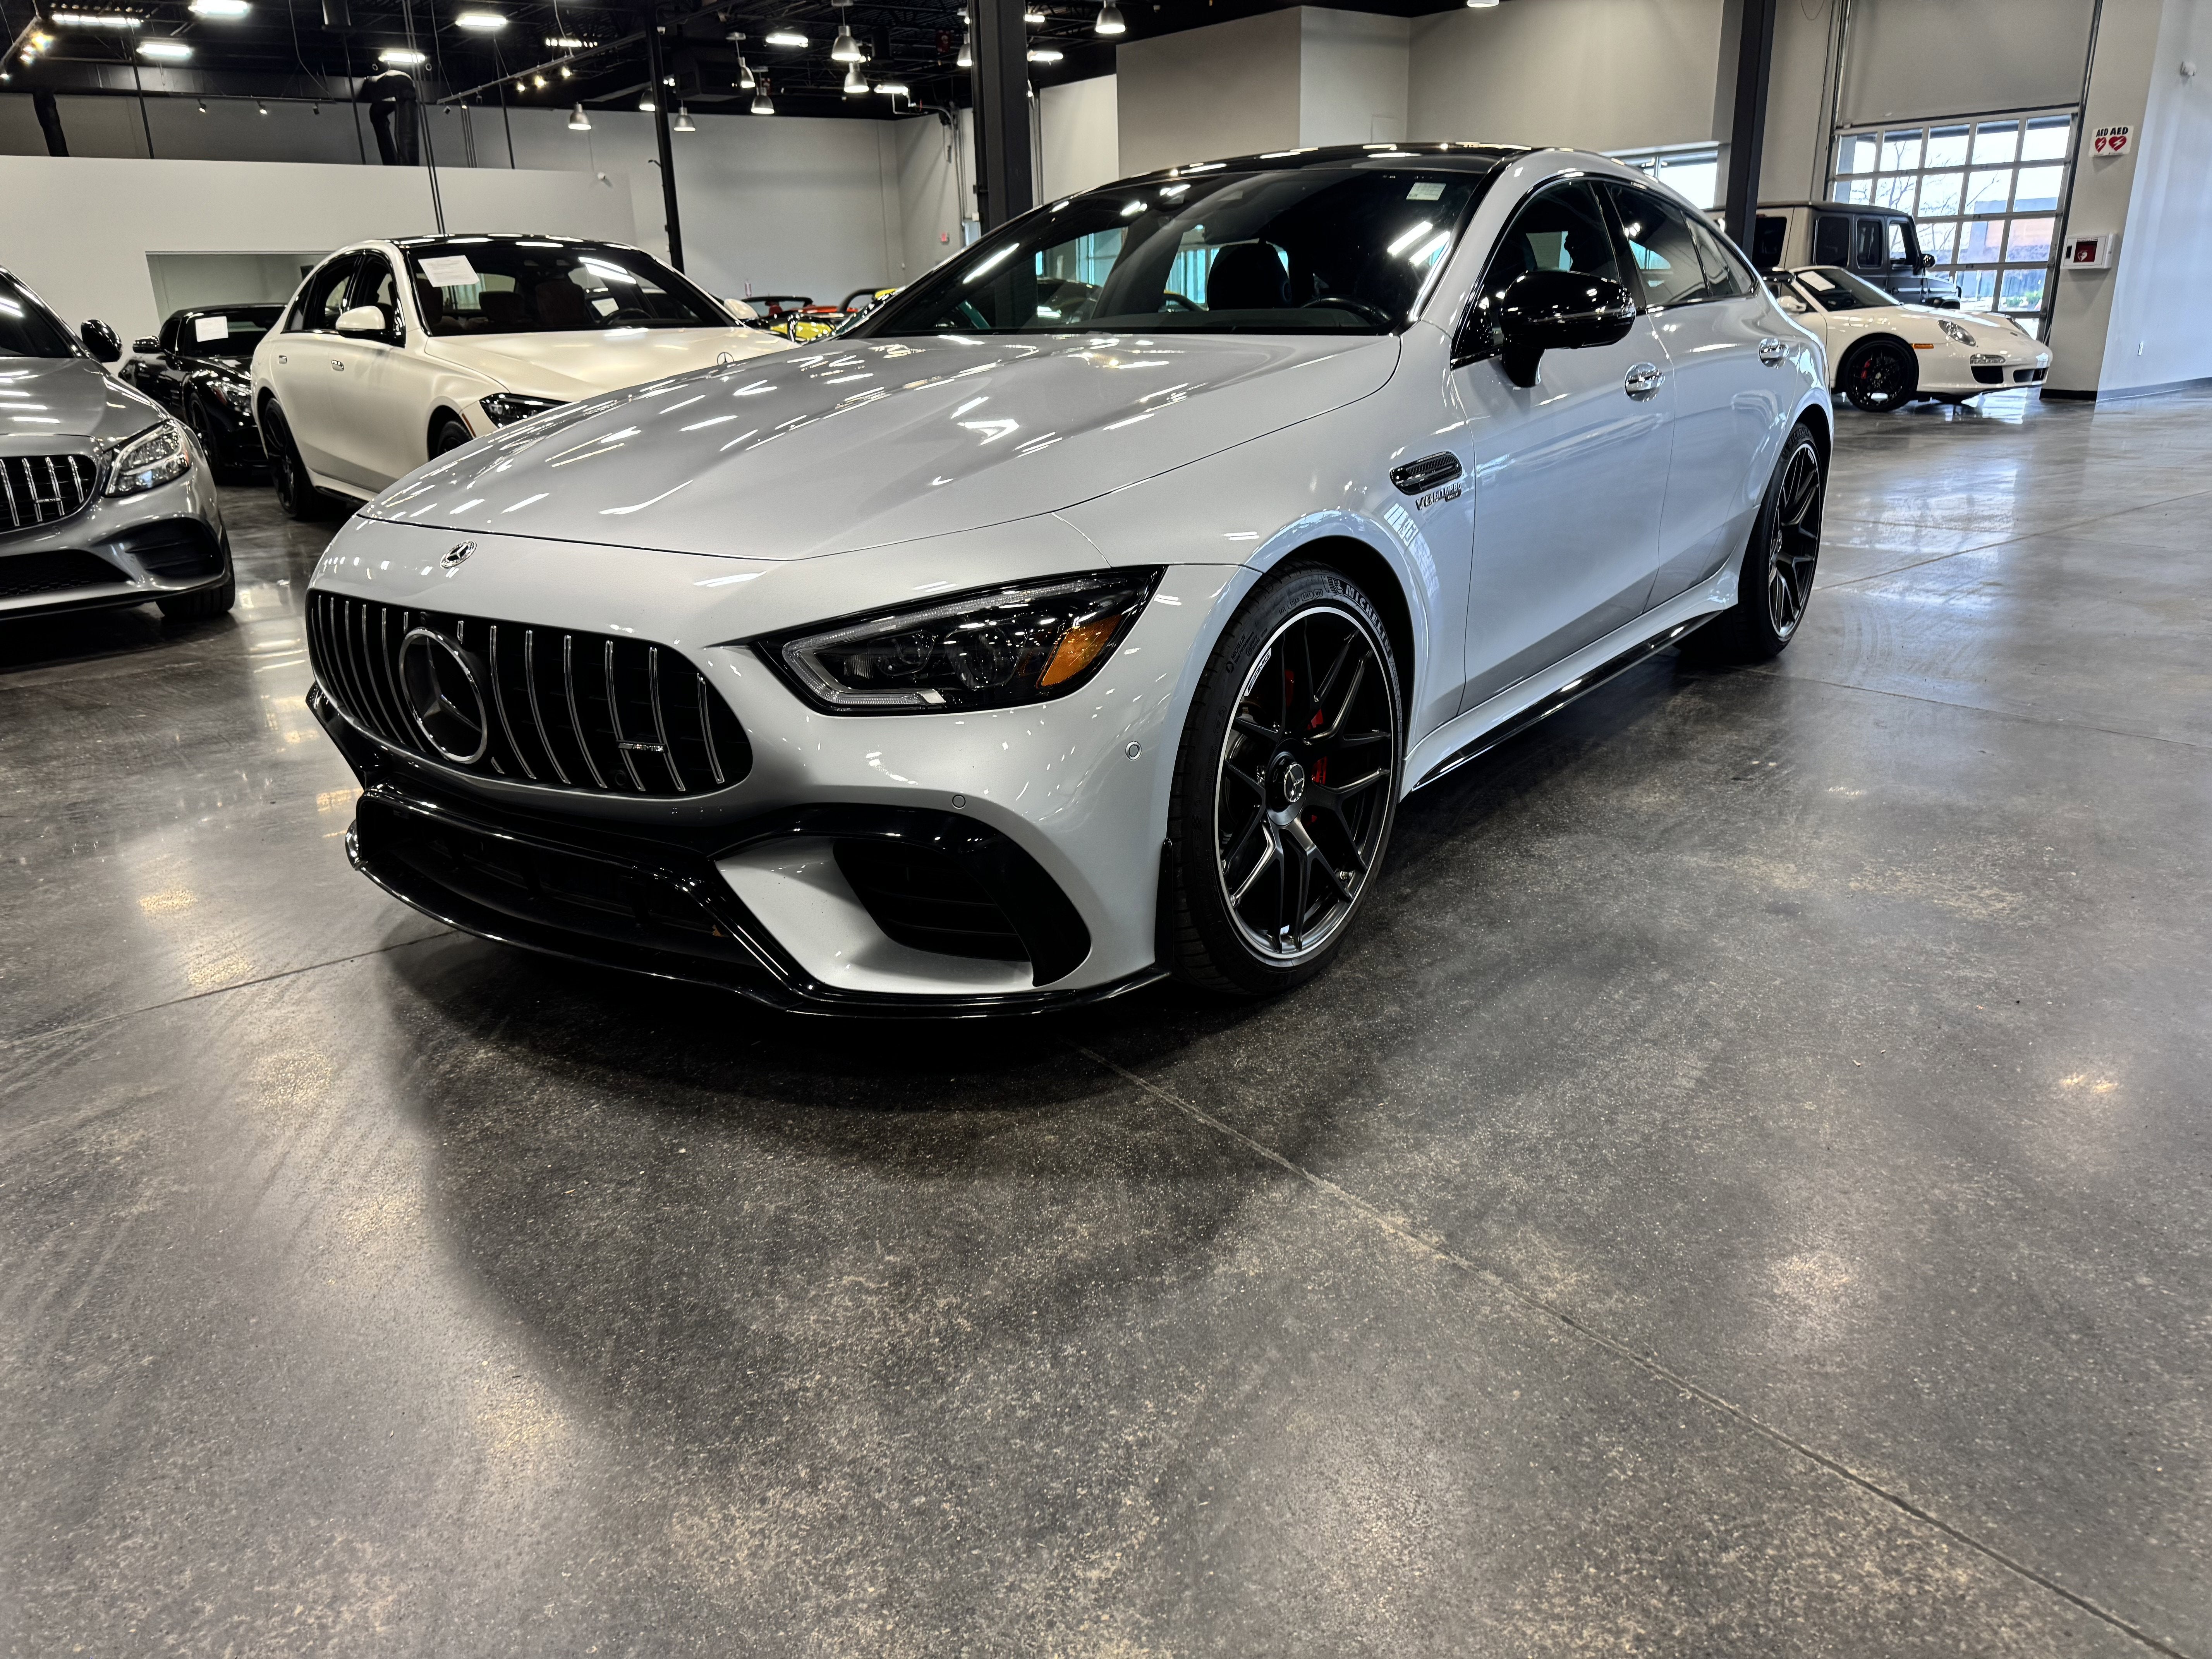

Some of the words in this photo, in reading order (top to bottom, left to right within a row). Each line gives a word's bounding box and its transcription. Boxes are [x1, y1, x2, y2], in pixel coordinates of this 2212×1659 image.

[2096, 128, 2108, 137] AED
[2110, 127, 2128, 136] AED
[1346, 584, 1391, 653] MICHELIN
[1231, 634, 1246, 661] MICHELIN
[1254, 653, 1270, 678] AMG
